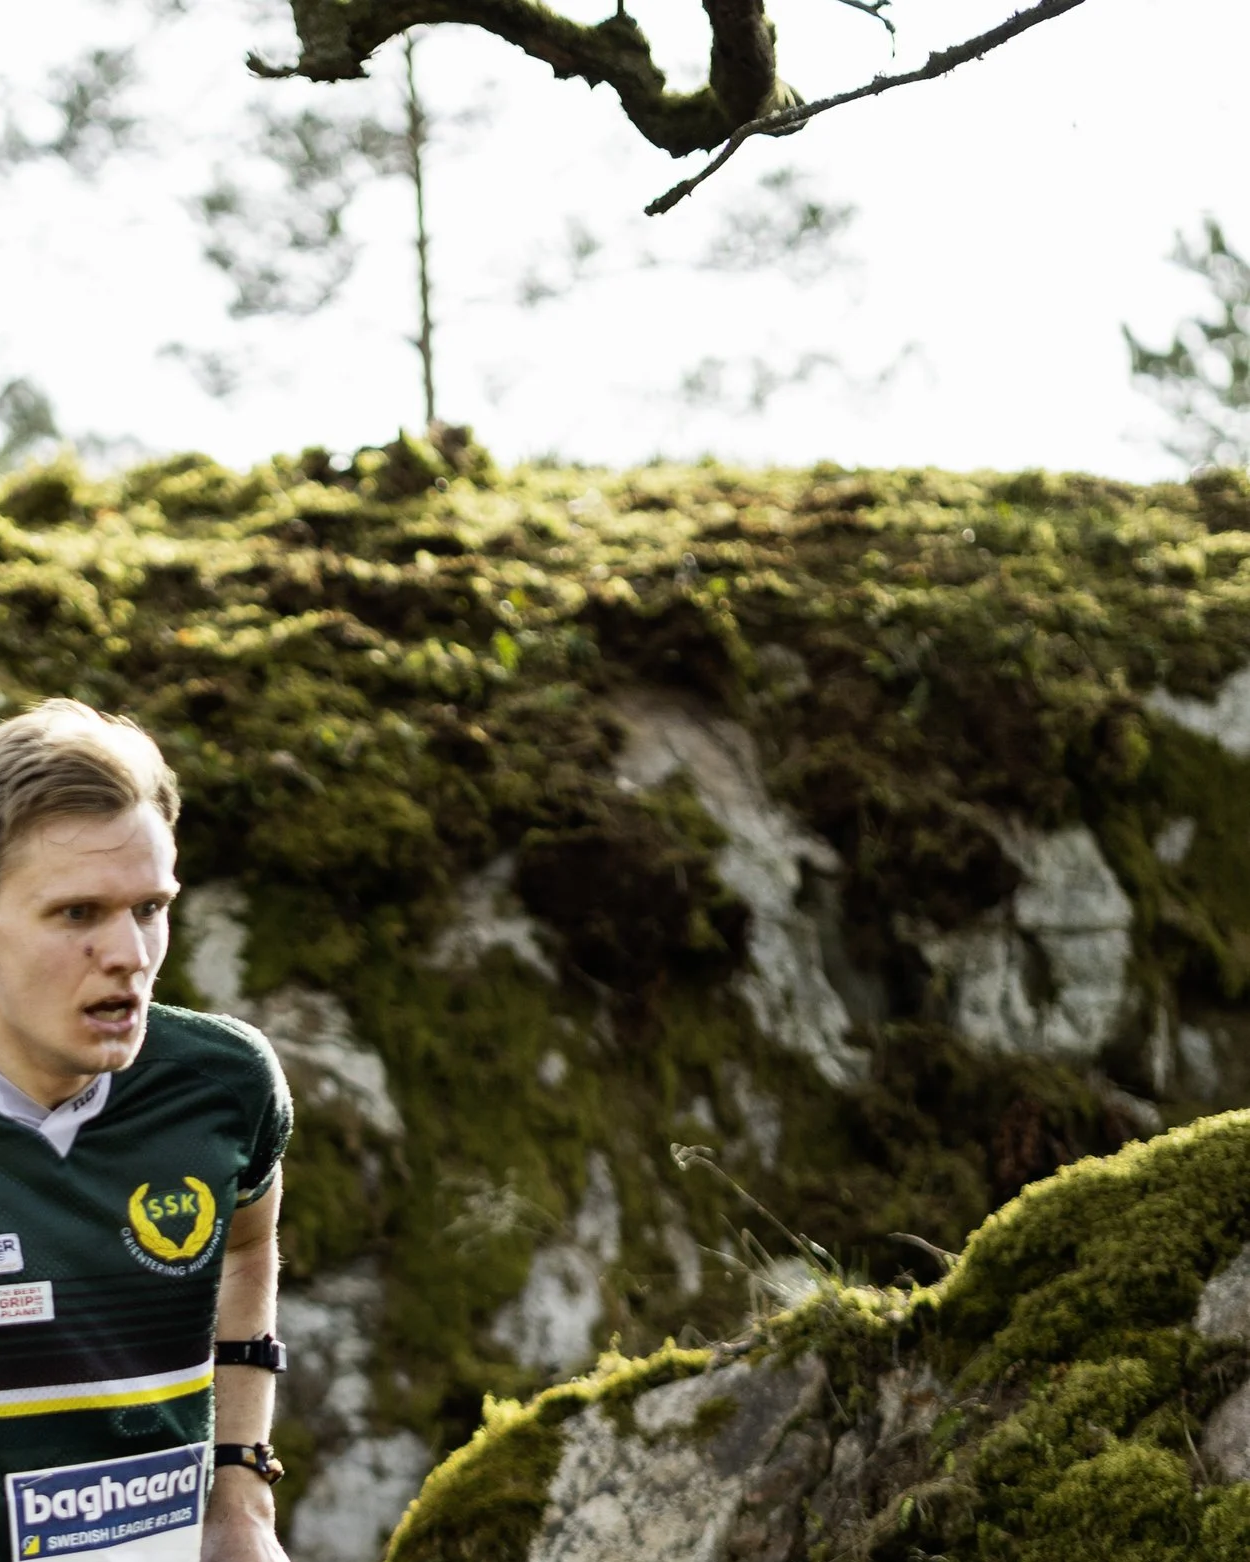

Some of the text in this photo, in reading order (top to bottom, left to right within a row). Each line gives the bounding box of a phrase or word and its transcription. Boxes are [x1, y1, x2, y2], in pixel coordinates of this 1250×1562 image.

[148, 1194, 197, 1220] SSK
[120, 1226, 187, 1277] ORIENTERING
[0, 1296, 34, 1309] GRIP
[13, 1286, 42, 1296] BEST
[0, 1307, 44, 1318] PLANET
[24, 1464, 198, 1524] bagheera
[47, 1528, 110, 1550] SWEDISH
[110, 1517, 155, 1540] LEAGUE
[168, 1506, 192, 1526] 2025
